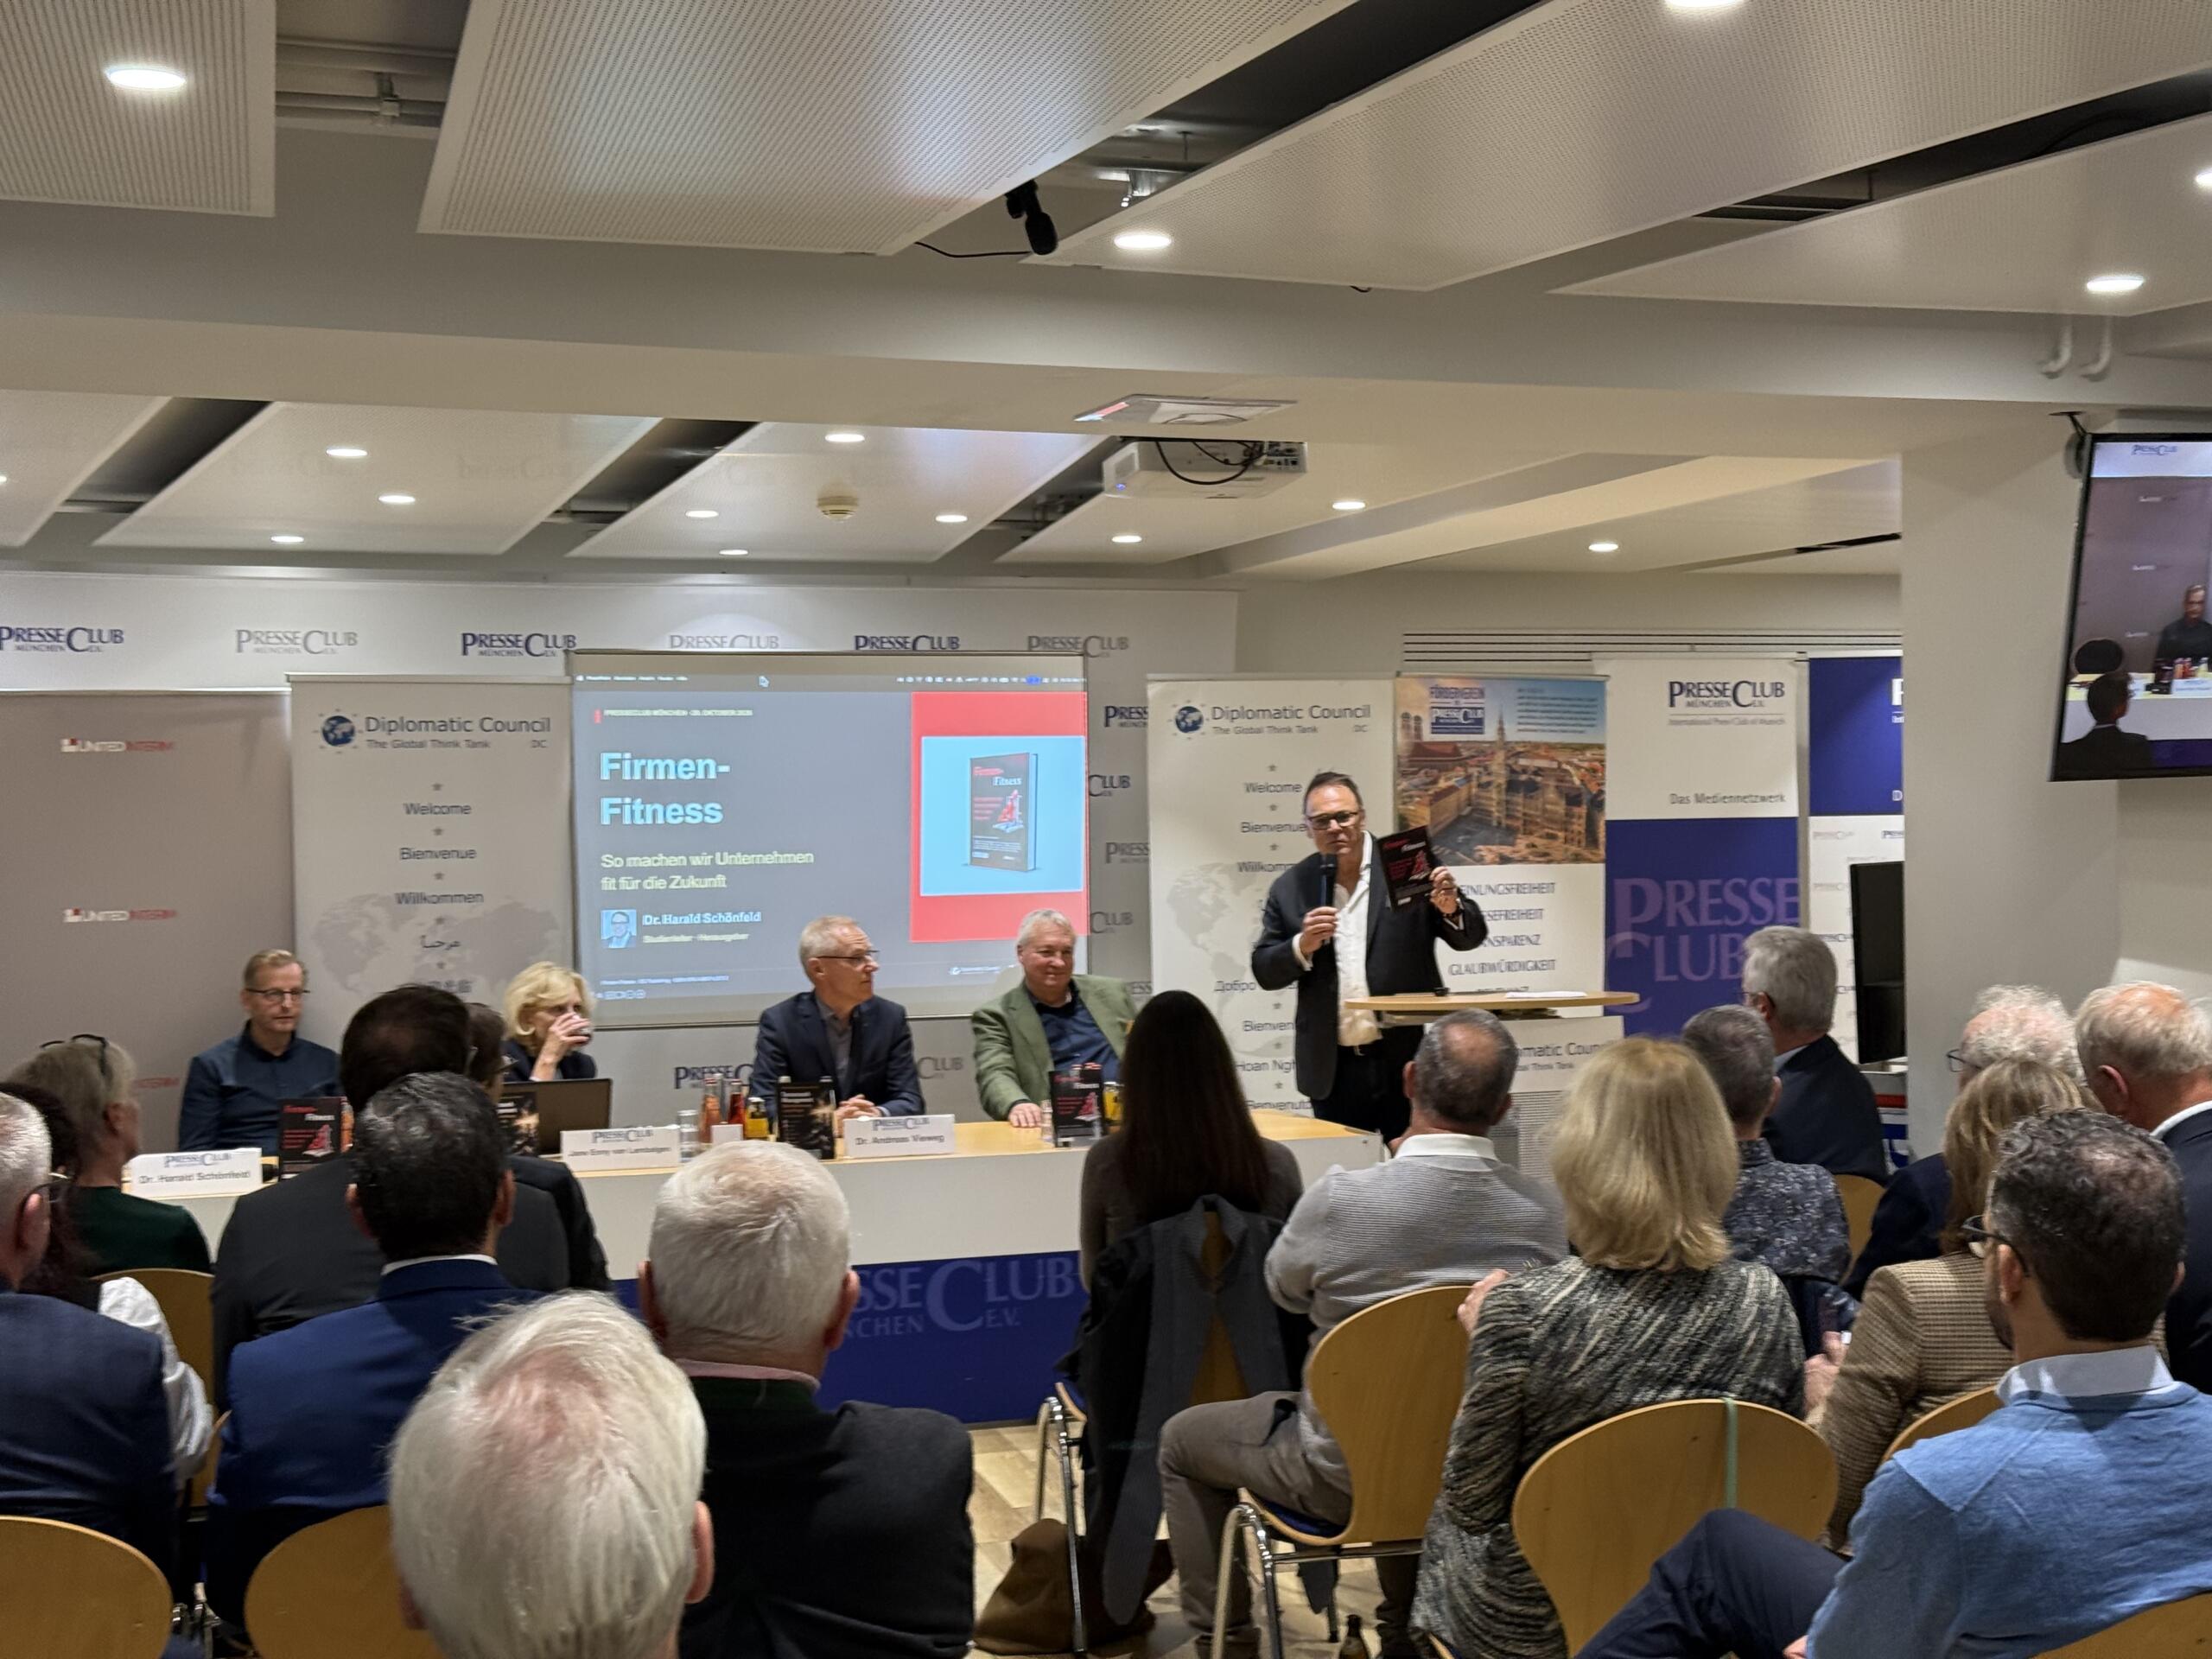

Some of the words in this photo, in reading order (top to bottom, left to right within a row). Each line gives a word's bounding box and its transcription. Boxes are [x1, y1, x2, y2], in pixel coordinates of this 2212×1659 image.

[1669, 681, 1785, 708] PRESSECLUB
[1211, 705, 1304, 723] Diplomatic
[1308, 704, 1371, 720] Council
[365, 716, 474, 735] Diplomatic
[479, 716, 551, 733] Council
[600, 752, 730, 780] Firmen-
[1245, 782, 1302, 793] Welcome
[1670, 793, 1691, 804] Das
[403, 803, 472, 815] Welcome
[600, 798, 724, 825] Fitness
[1241, 822, 1307, 833] Bienvenue
[399, 847, 477, 861] Bienvenue
[601, 854, 624, 868] So
[626, 854, 687, 867] machen
[690, 852, 714, 866] wir
[715, 850, 814, 866] Unternehmen
[601, 876, 617, 891] fit
[619, 876, 641, 890] für
[642, 875, 667, 890] die
[669, 874, 728, 889] Zukunft
[1458, 882, 1555, 896] EINUNGSFREIHEIT
[394, 892, 484, 905] Willkommen
[642, 914, 662, 925] Dr.
[662, 913, 702, 925] Harald
[702, 912, 762, 924] Schönfeld
[1614, 878, 1800, 958] PRESSE
